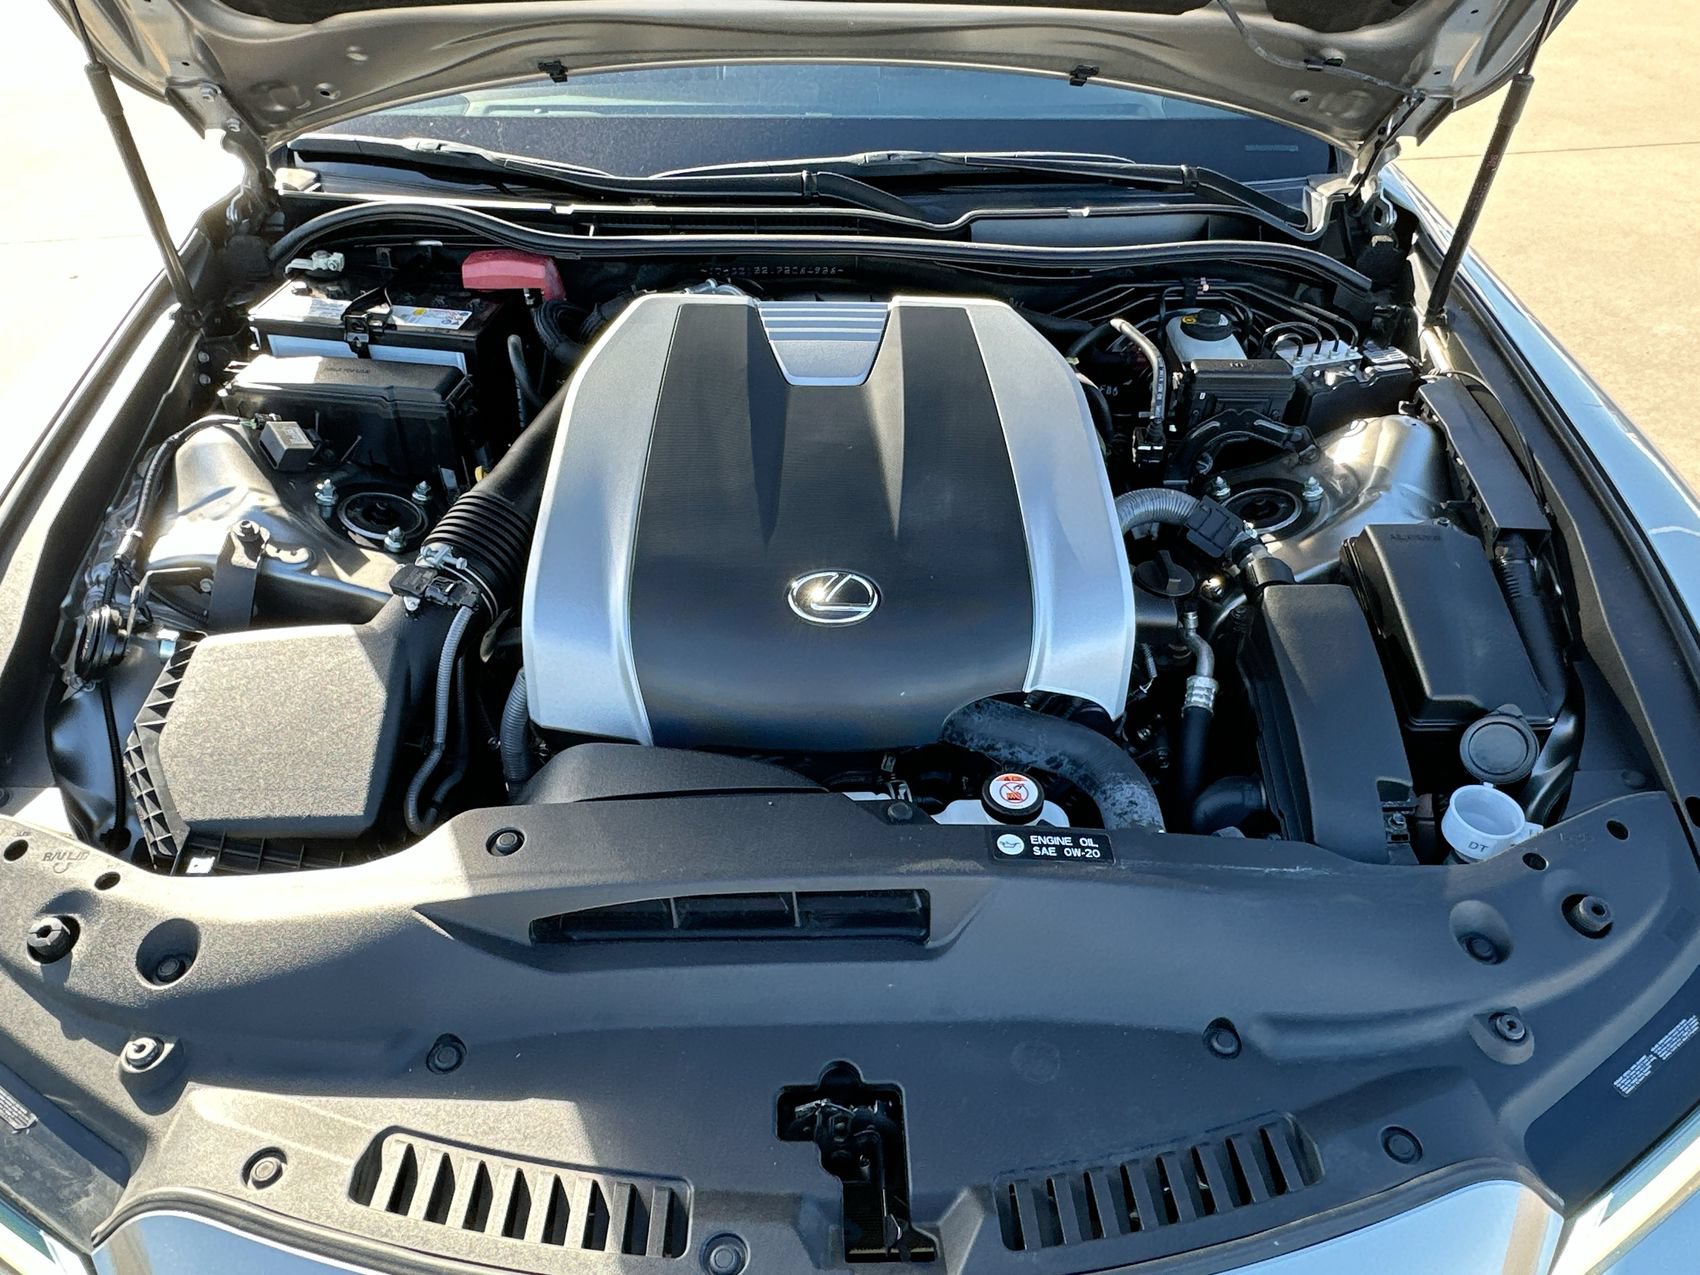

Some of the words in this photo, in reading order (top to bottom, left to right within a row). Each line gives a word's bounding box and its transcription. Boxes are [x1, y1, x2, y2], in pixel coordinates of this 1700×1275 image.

[1030, 835, 1073, 846] ENGINE
[1080, 837, 1099, 848] OIL
[1468, 841, 1489, 852] DT
[1033, 846, 1057, 857] SAE
[1064, 847, 1101, 858] 0W-20
